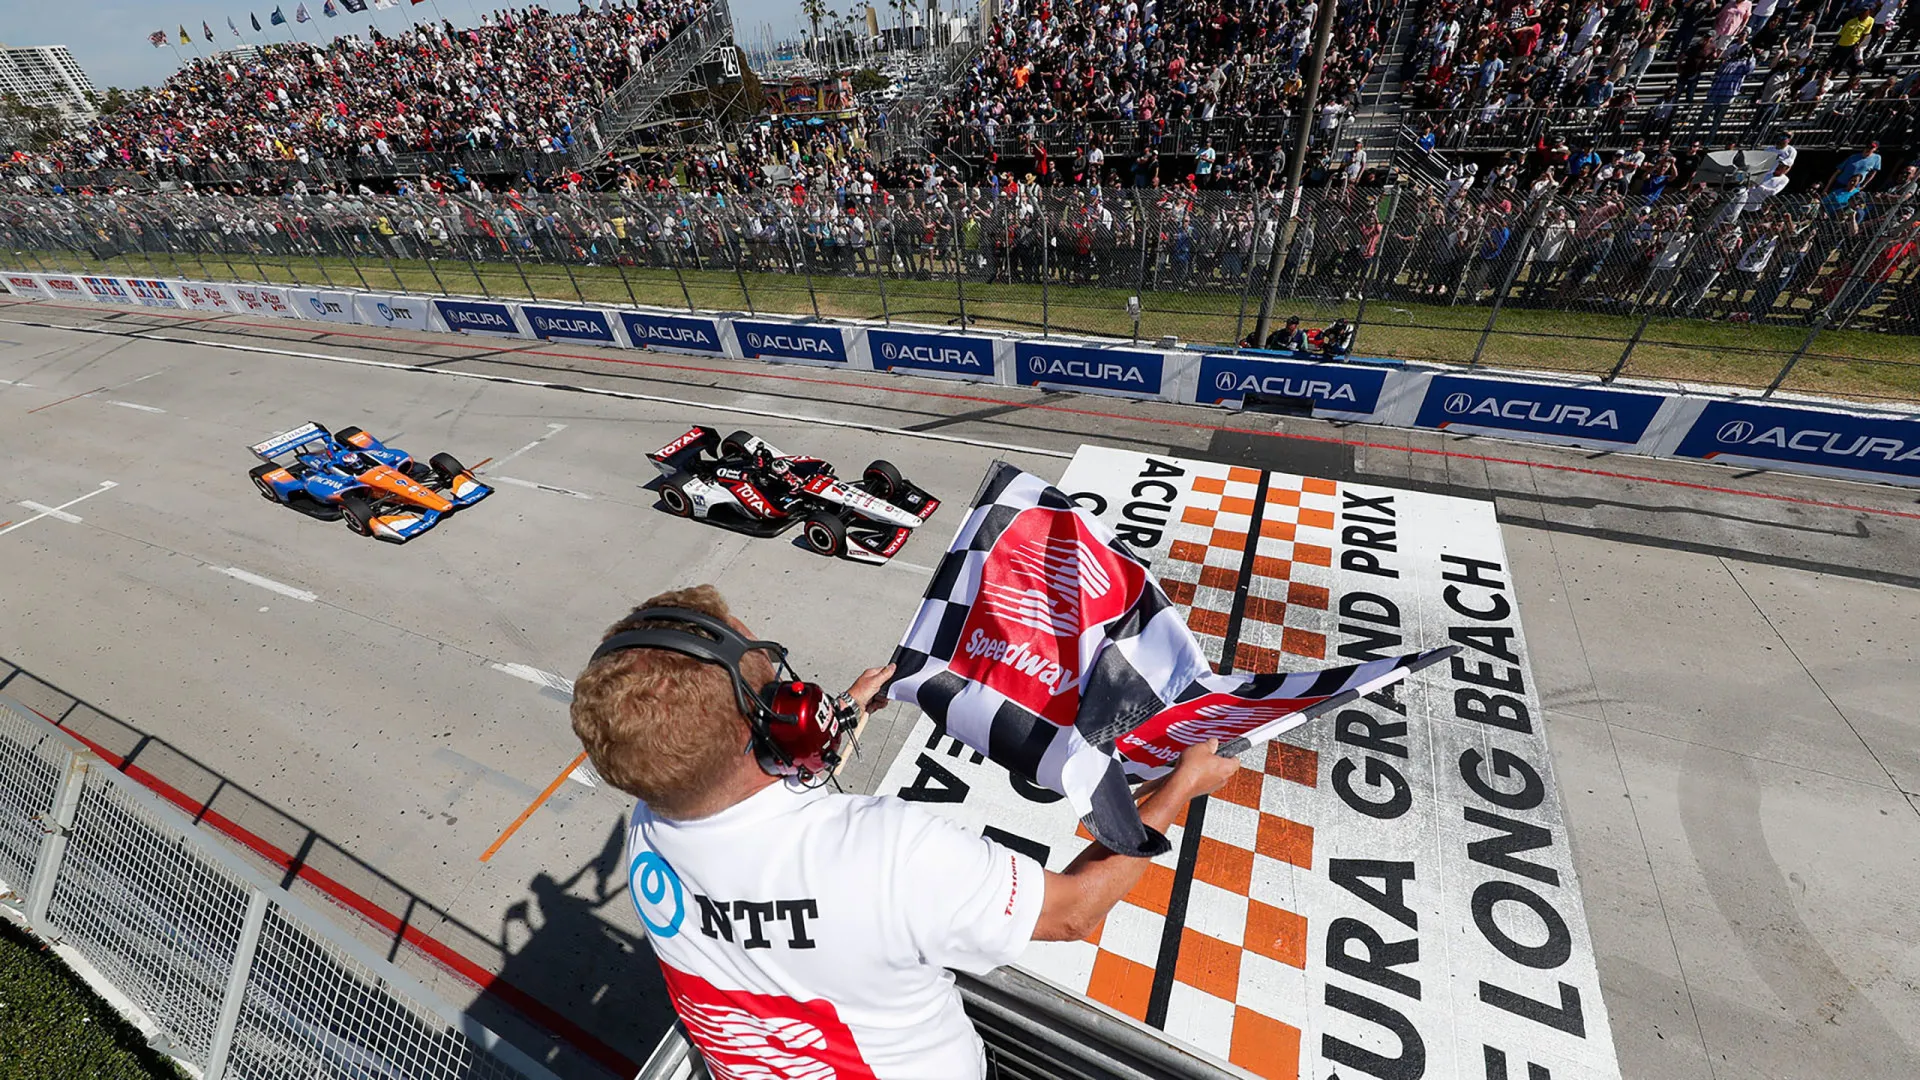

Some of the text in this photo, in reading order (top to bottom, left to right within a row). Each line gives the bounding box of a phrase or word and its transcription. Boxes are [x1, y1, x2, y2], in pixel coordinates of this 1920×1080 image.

[722, 48, 739, 75] 29
[323, 302, 343, 313] NTT
[391, 308, 412, 319] NTT
[458, 311, 507, 327] ACURA
[547, 318, 603, 335] ACURA
[648, 326, 710, 344] ACURA
[763, 335, 834, 354] ACURA
[898, 348, 980, 366] ACURA
[1047, 360, 1145, 383] ACURA
[1237, 375, 1356, 401] ACURA
[1470, 397, 1619, 430] ACURA
[653, 429, 703, 459] TOTAL
[736, 482, 775, 518] TOTAL
[1114, 457, 1186, 570] ACUR
[1340, 490, 1400, 579] PRIX
[1440, 553, 1534, 735] BEACH
[965, 628, 1080, 697] Speedway
[1005, 855, 1018, 916] Firestone
[1458, 747, 1586, 1040] LONG
[695, 894, 818, 950] NTT
[1321, 858, 1426, 1080] URA
